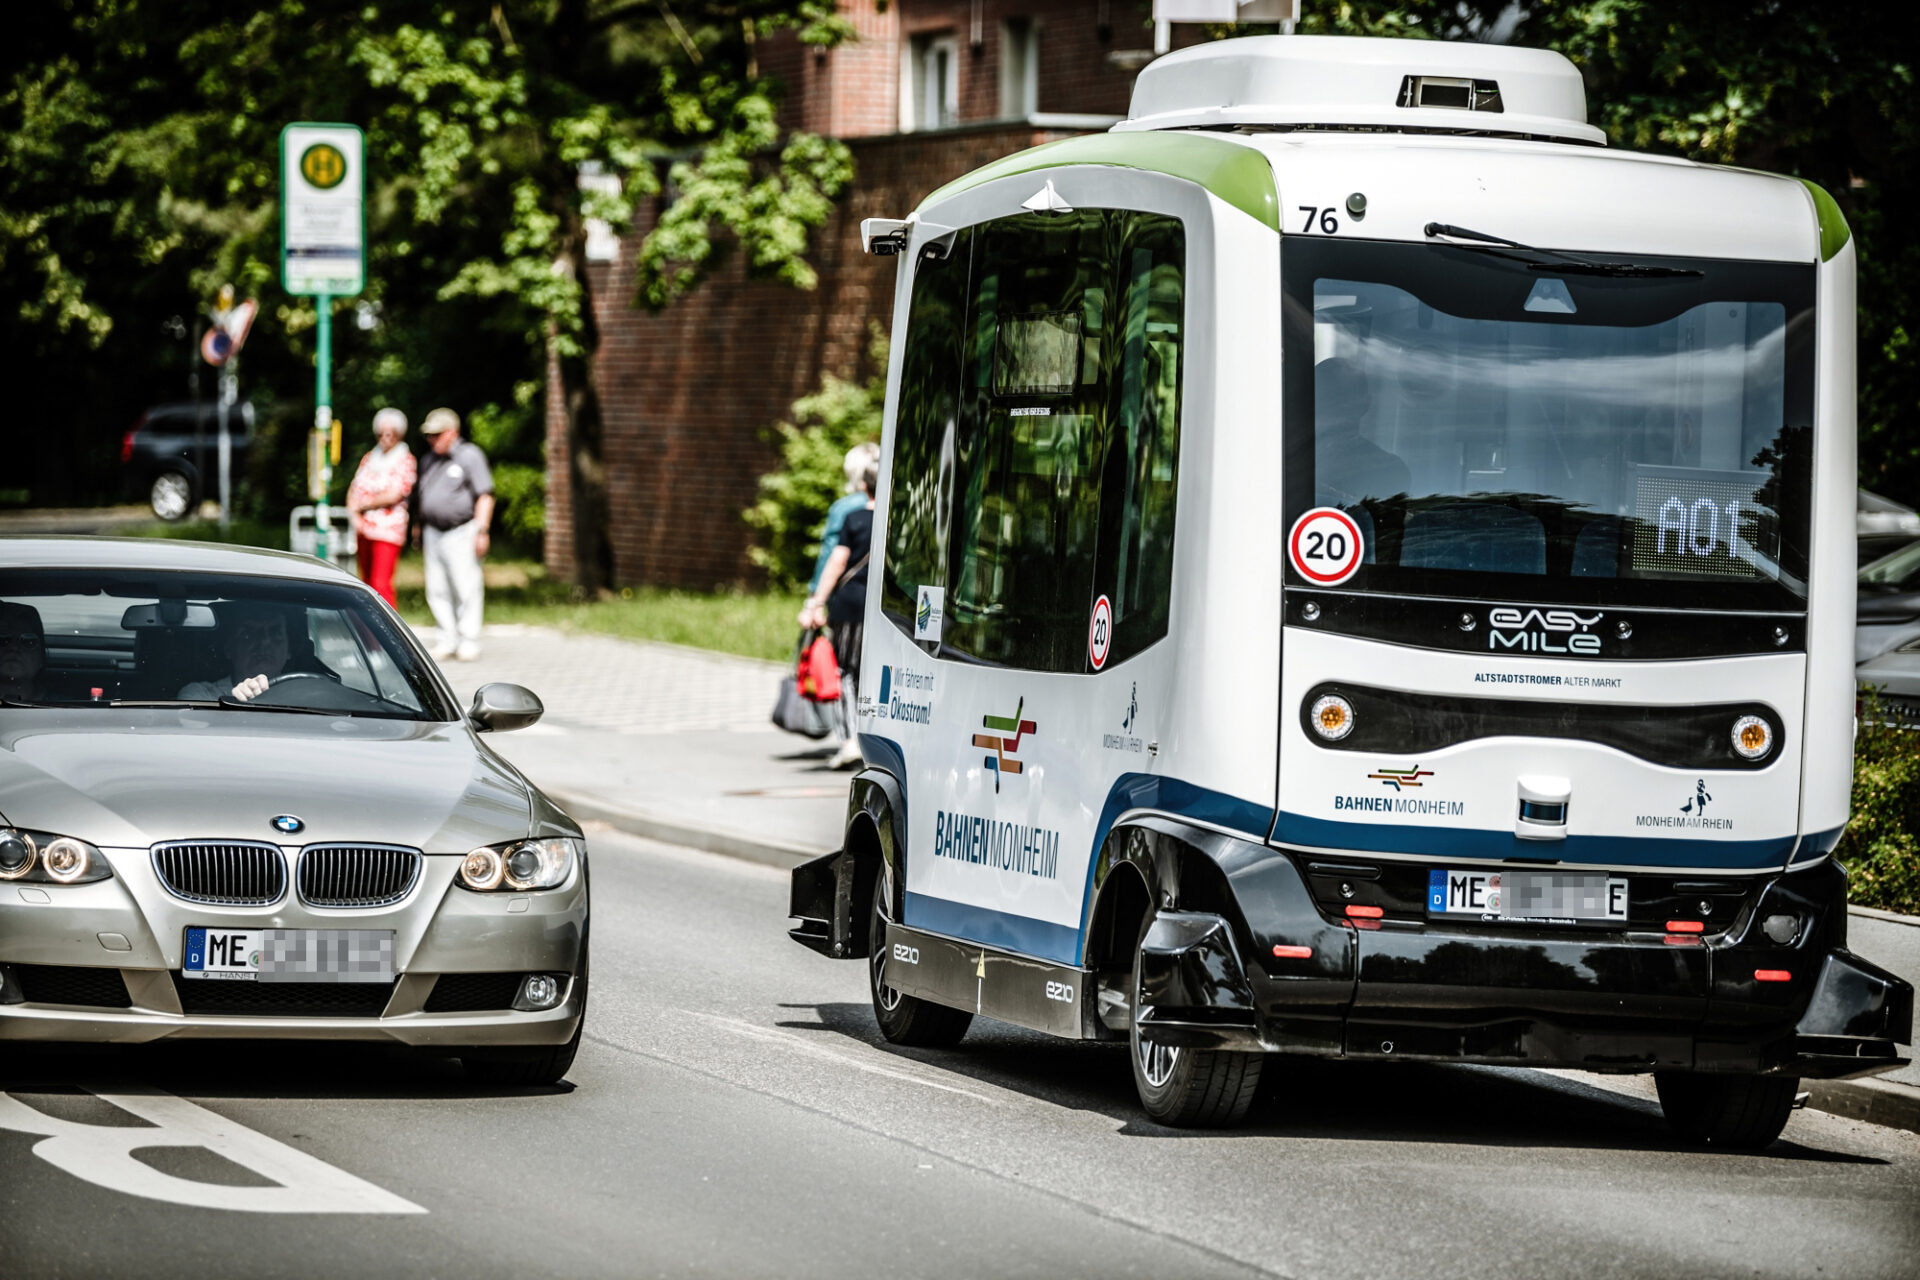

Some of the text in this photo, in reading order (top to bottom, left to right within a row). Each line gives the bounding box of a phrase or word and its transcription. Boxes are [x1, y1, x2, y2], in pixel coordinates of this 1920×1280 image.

[1299, 206, 1339, 235] 76
[1657, 496, 1740, 558] A01
[1306, 531, 1346, 561] 20
[1094, 618, 1107, 646] 20
[894, 667, 905, 686] Wir
[905, 667, 923, 690] fahren
[1474, 673, 1622, 688] ALTSTADTSTROMER ALTER MARKT
[890, 690, 932, 725] Ökostrom!
[1450, 876, 1486, 908] ME
[208, 934, 248, 966] ME
